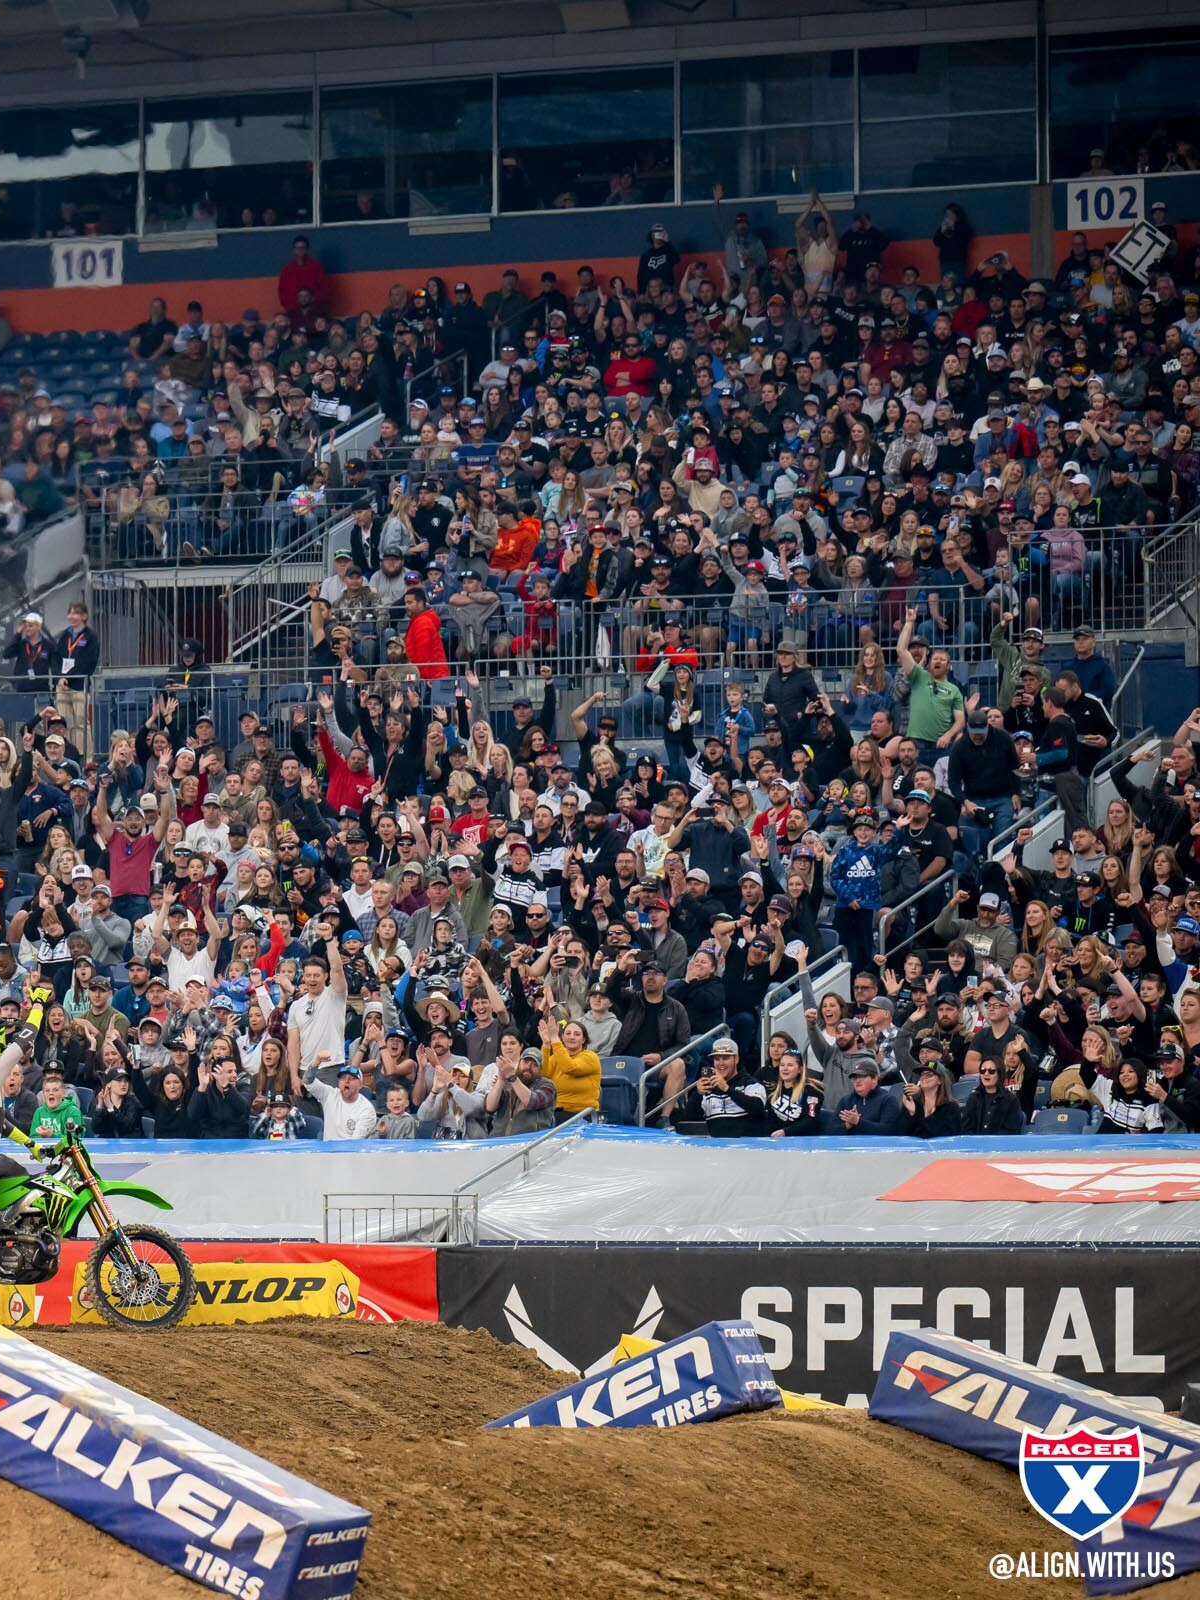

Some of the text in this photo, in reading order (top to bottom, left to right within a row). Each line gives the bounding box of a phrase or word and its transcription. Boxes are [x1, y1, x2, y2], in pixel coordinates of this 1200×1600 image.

[1075, 186, 1138, 222] 102
[62, 247, 115, 280] 101
[847, 869, 876, 878] adidas
[723, 1327, 757, 1338] FALKEN
[740, 1286, 1166, 1373] SPECIAL
[651, 1385, 722, 1428] TIRES
[307, 1526, 368, 1547] FALKEN
[184, 1544, 265, 1600] TIRES
[298, 1559, 359, 1580] FALKEN
